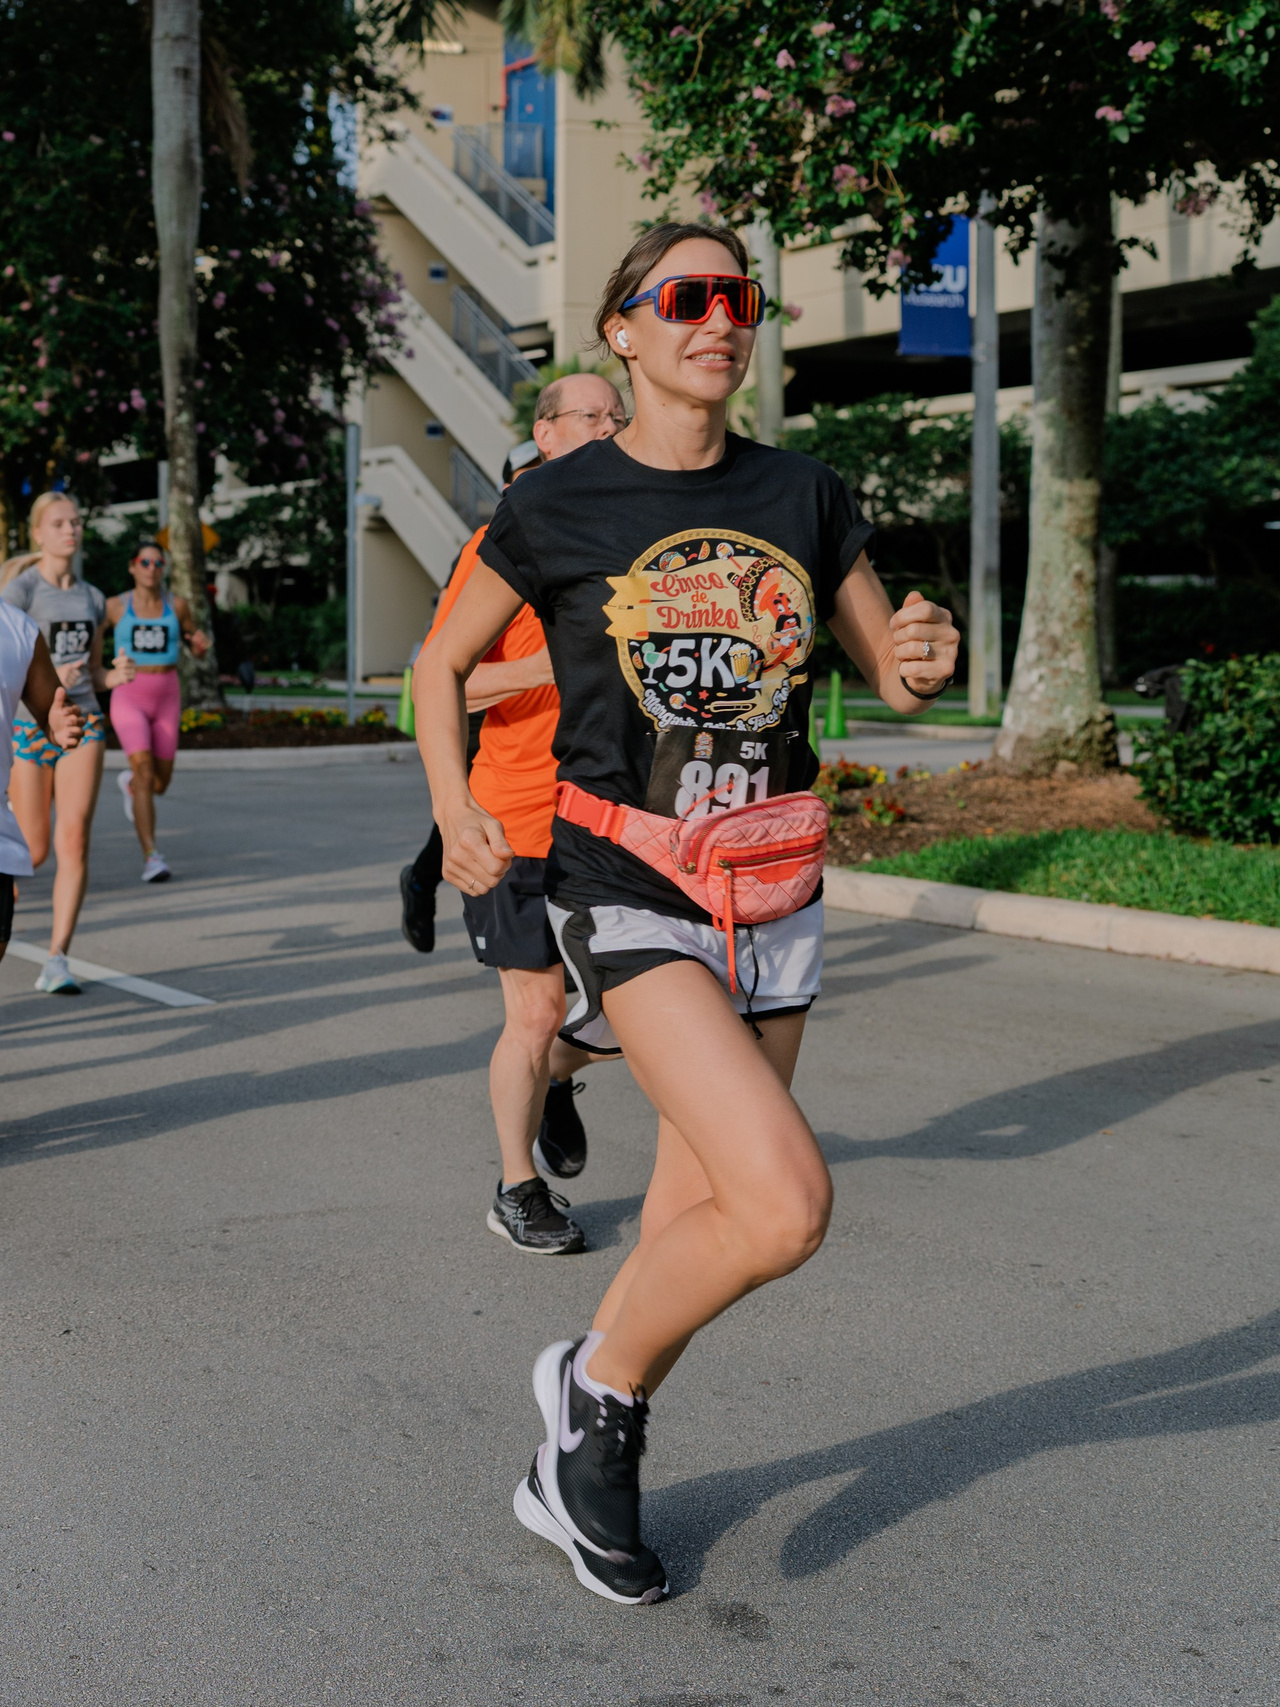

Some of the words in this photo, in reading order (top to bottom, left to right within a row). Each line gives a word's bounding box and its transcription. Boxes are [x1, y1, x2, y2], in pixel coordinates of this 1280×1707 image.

[650, 572, 728, 597] Cinco
[691, 590, 709, 604] de
[656, 604, 741, 630] Drinko
[55, 630, 90, 654] 852
[665, 637, 735, 688] 5K
[739, 741, 769, 760] 5K
[674, 760, 770, 821] 891
